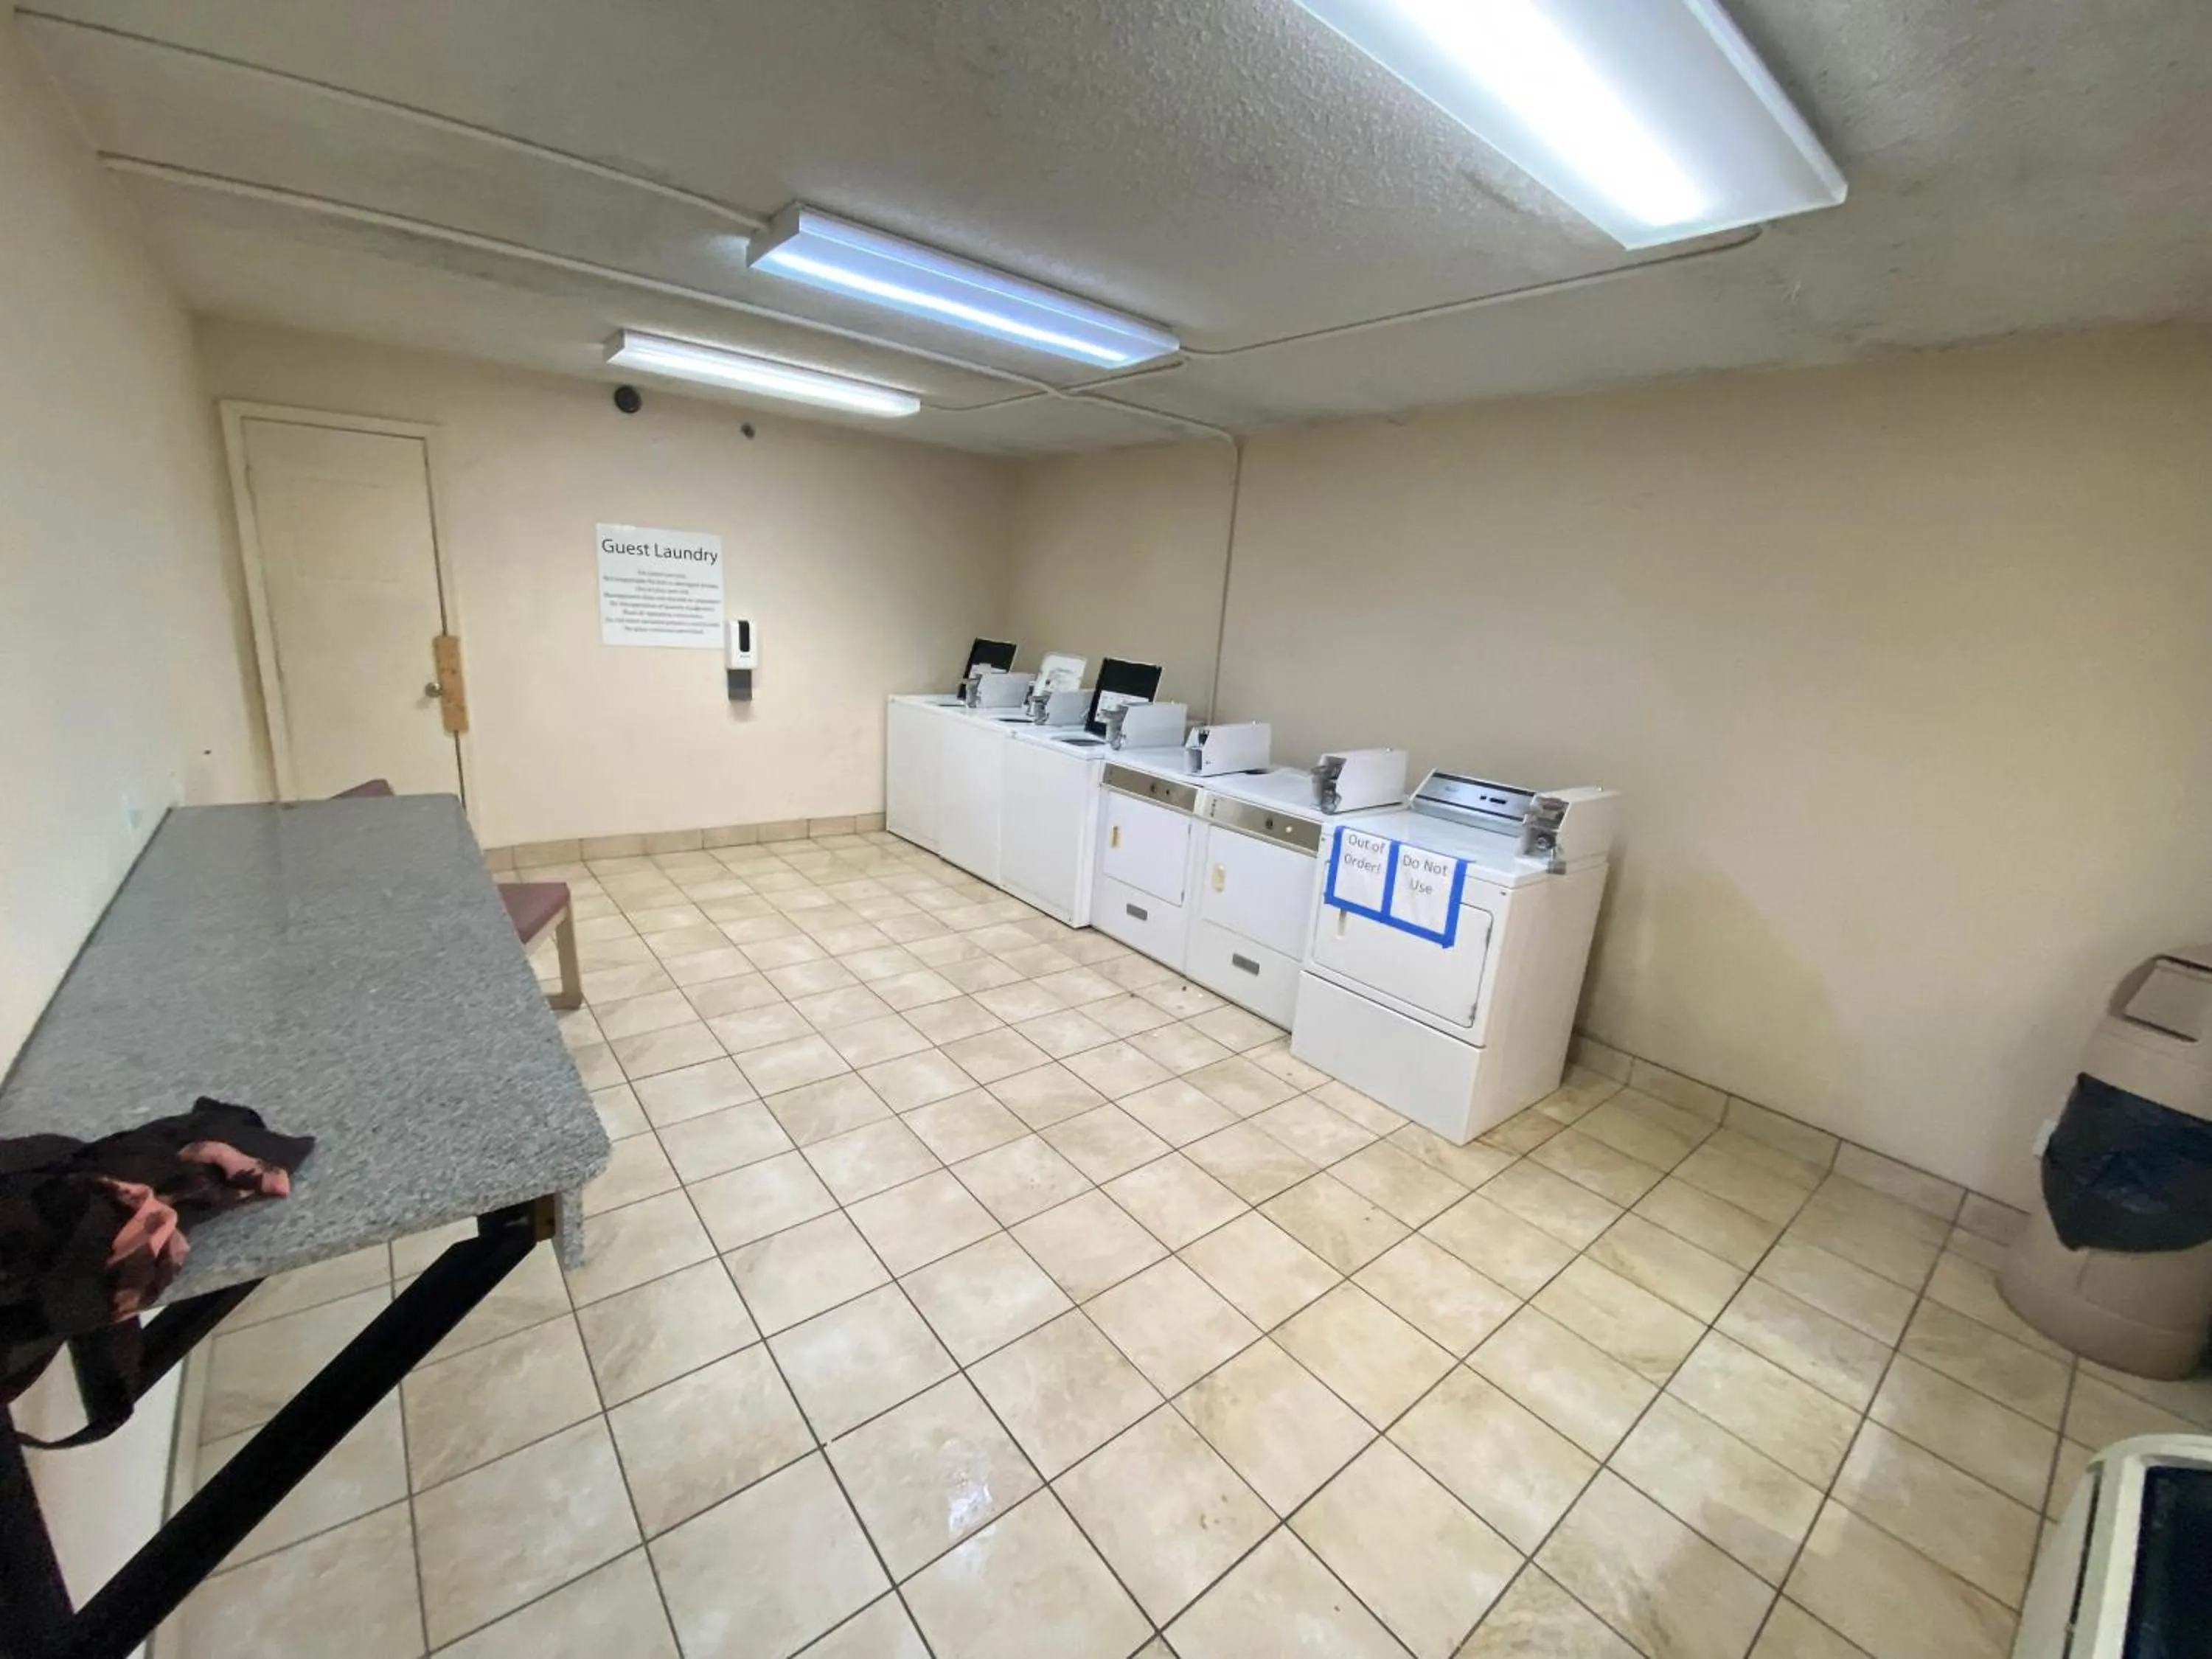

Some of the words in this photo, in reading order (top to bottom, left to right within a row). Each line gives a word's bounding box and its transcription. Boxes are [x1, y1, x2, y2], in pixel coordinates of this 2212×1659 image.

[601, 538, 650, 557] Guest
[654, 542, 717, 566] Laundry
[1349, 834, 1369, 850] Out
[1371, 842, 1385, 854] of
[1344, 853, 1381, 874] Order!
[1402, 855, 1419, 869] Do
[1424, 859, 1449, 877] Not
[1410, 877, 1433, 894] Use
